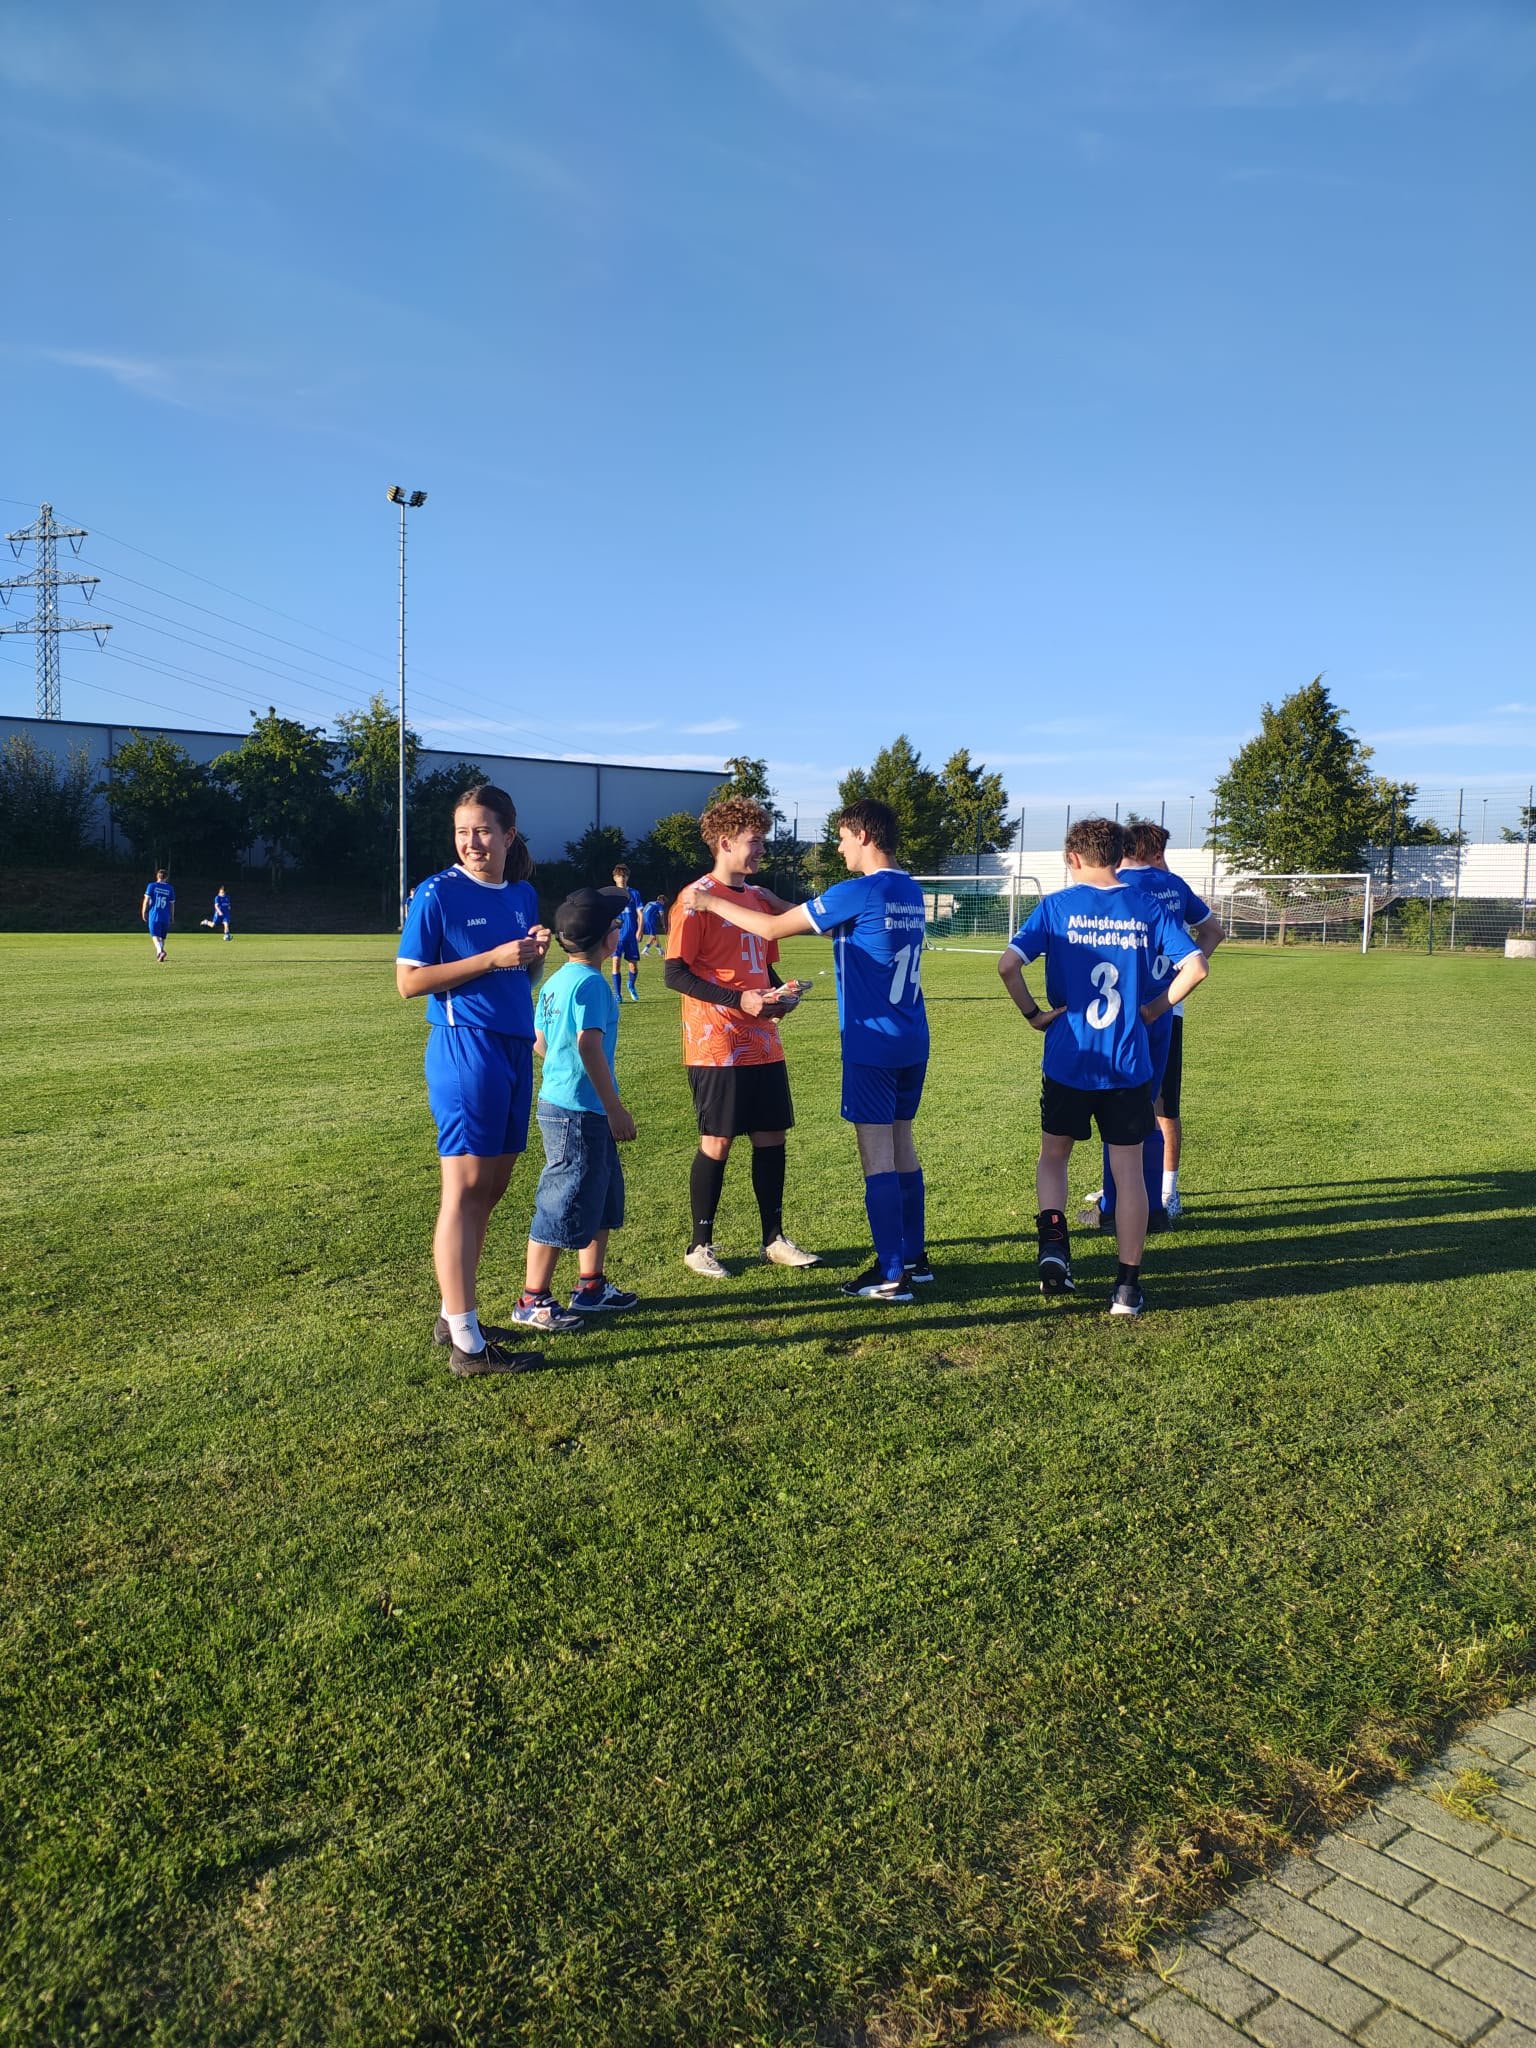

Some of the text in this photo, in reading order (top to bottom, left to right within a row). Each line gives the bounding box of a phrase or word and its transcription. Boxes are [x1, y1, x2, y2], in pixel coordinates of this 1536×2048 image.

[466, 918, 487, 926] JAKO
[1068, 915, 1148, 931] Ministranten
[1067, 930, 1148, 950] Dreifaltigkeit
[1086, 962, 1121, 1029] 3
